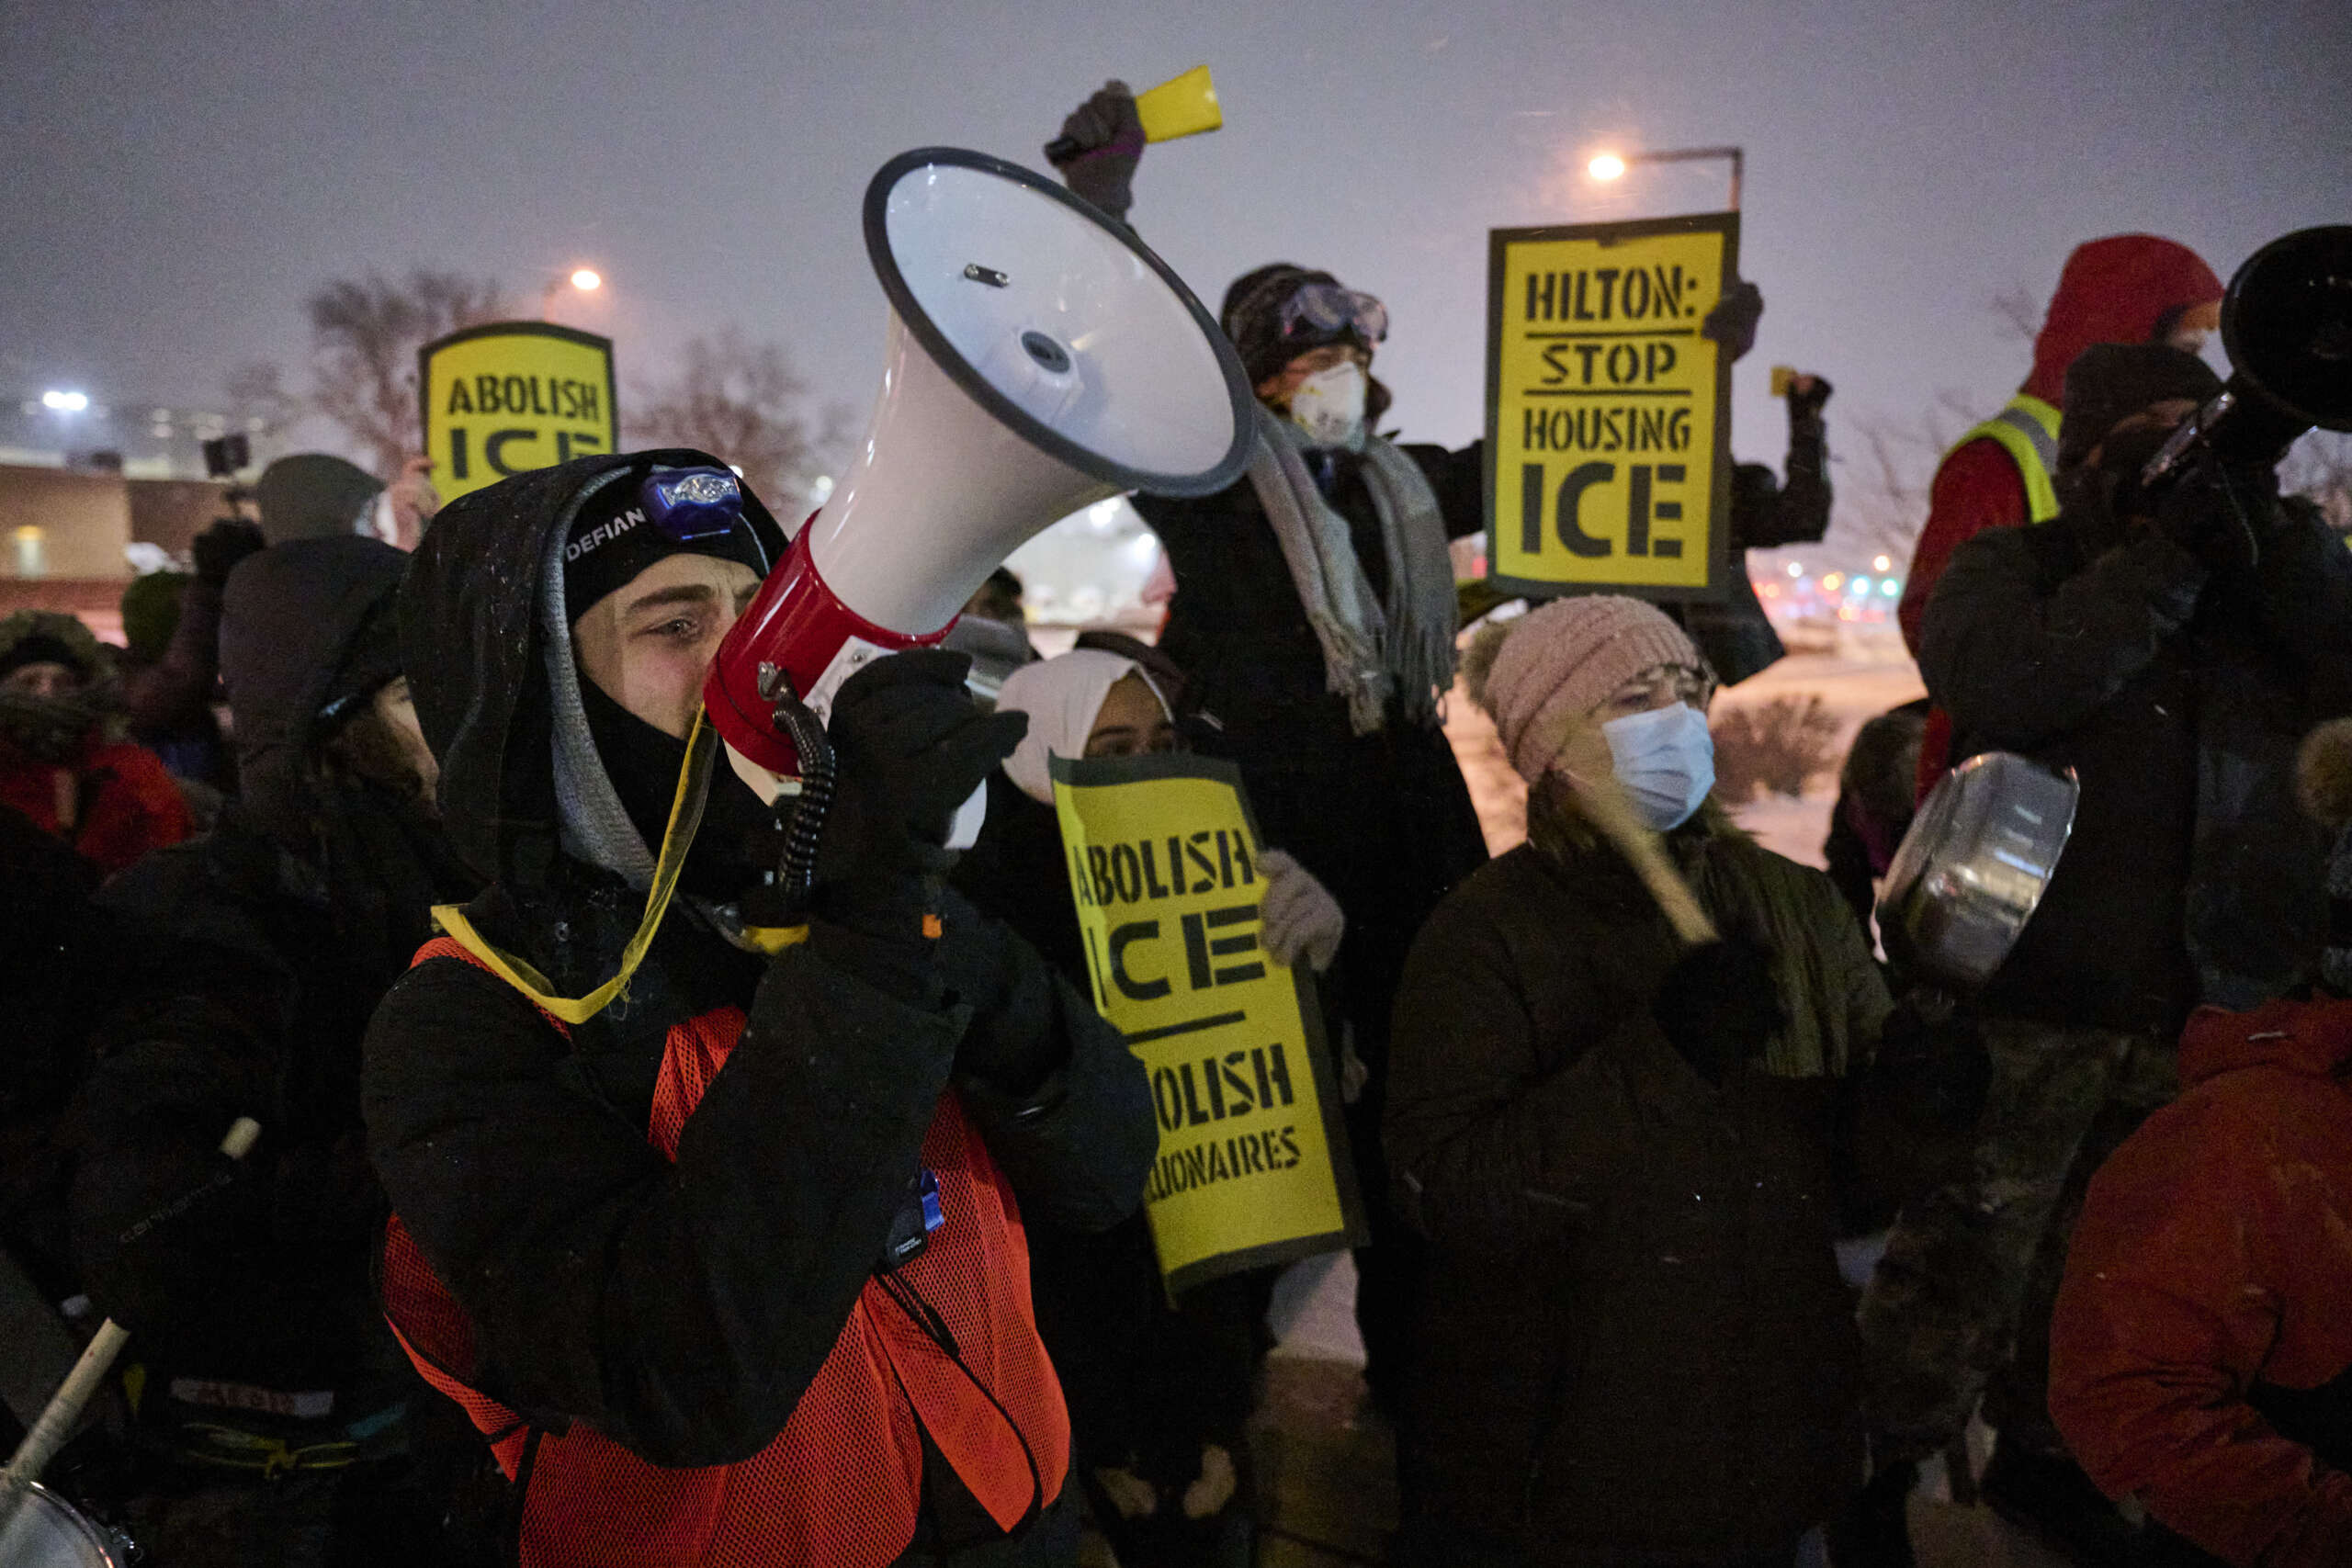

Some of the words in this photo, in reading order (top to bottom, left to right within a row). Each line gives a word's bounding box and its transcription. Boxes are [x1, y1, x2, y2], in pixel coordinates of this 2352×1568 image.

[1525, 264, 1697, 321] HILTON:
[1541, 342, 1677, 386] STOP
[448, 376, 599, 422] ABOLISH
[1522, 407, 1691, 453] HOUSING
[566, 507, 647, 562] DEFIAN
[1521, 460, 1687, 559] ICE
[1073, 828, 1254, 907] ABOLISH
[1087, 904, 1266, 1010] ICE
[1153, 1042, 1295, 1133] OLISH
